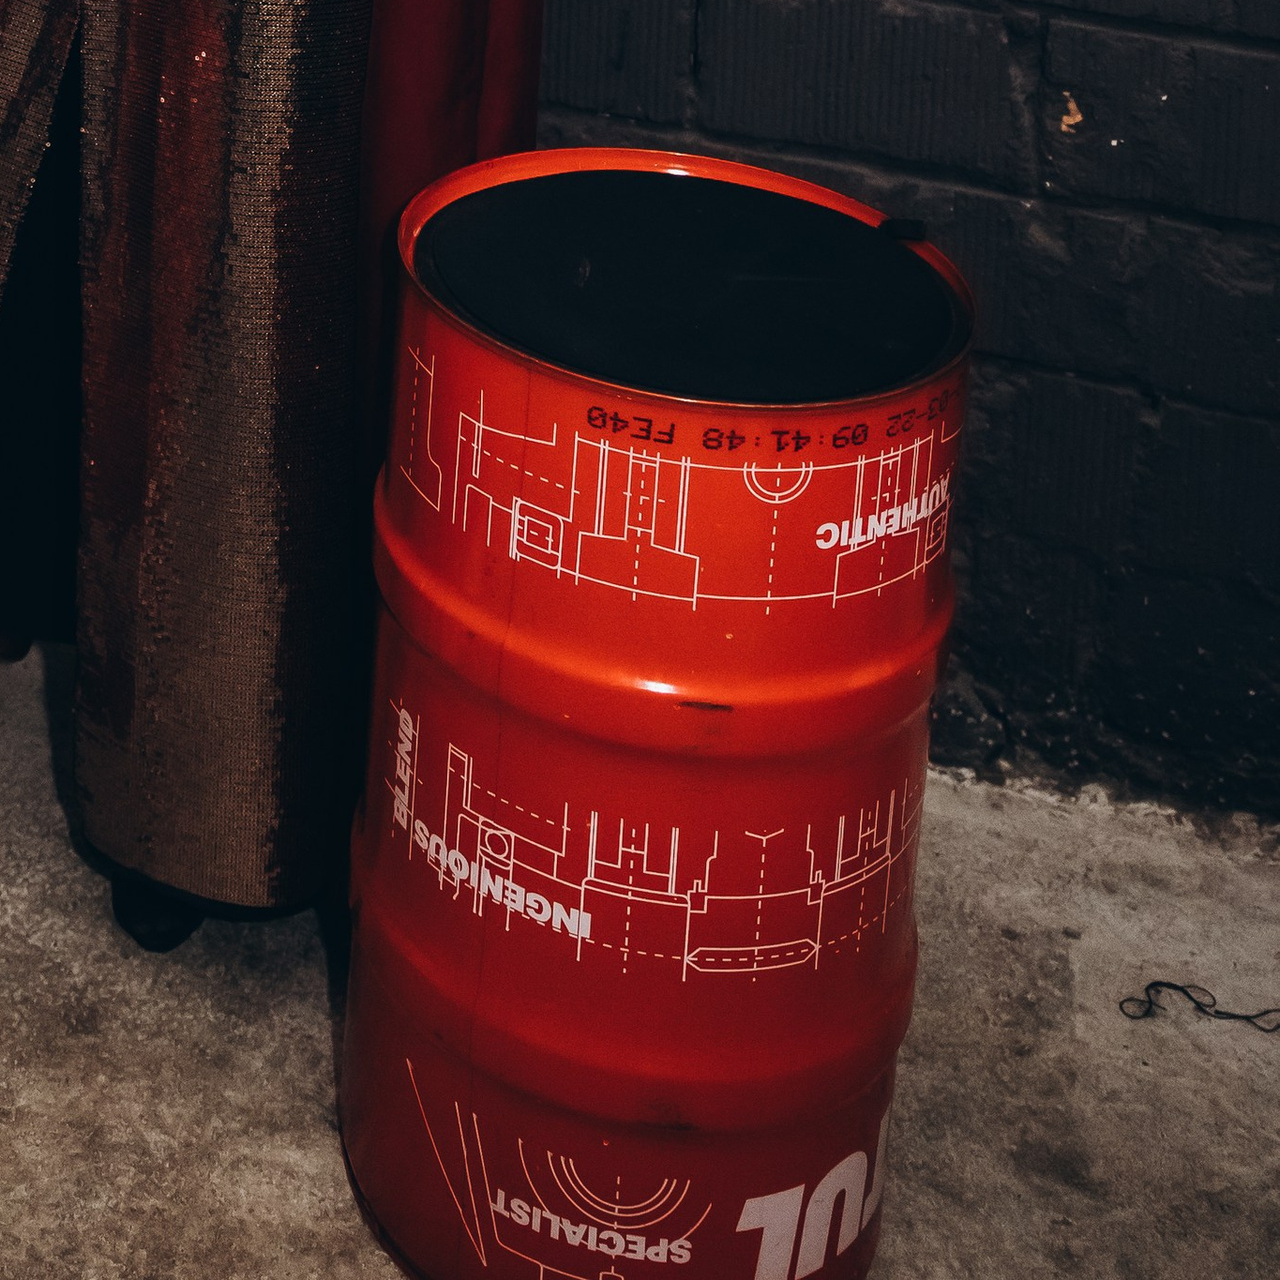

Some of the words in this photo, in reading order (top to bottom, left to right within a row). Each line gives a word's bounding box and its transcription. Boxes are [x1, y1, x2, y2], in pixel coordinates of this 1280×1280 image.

[587, 405, 675, 444] FE40
[816, 473, 949, 549] AUTHENTIC
[393, 709, 412, 830] BLEND
[413, 820, 591, 938] INGENIOUS
[491, 1187, 692, 1264] SPECIALIST
